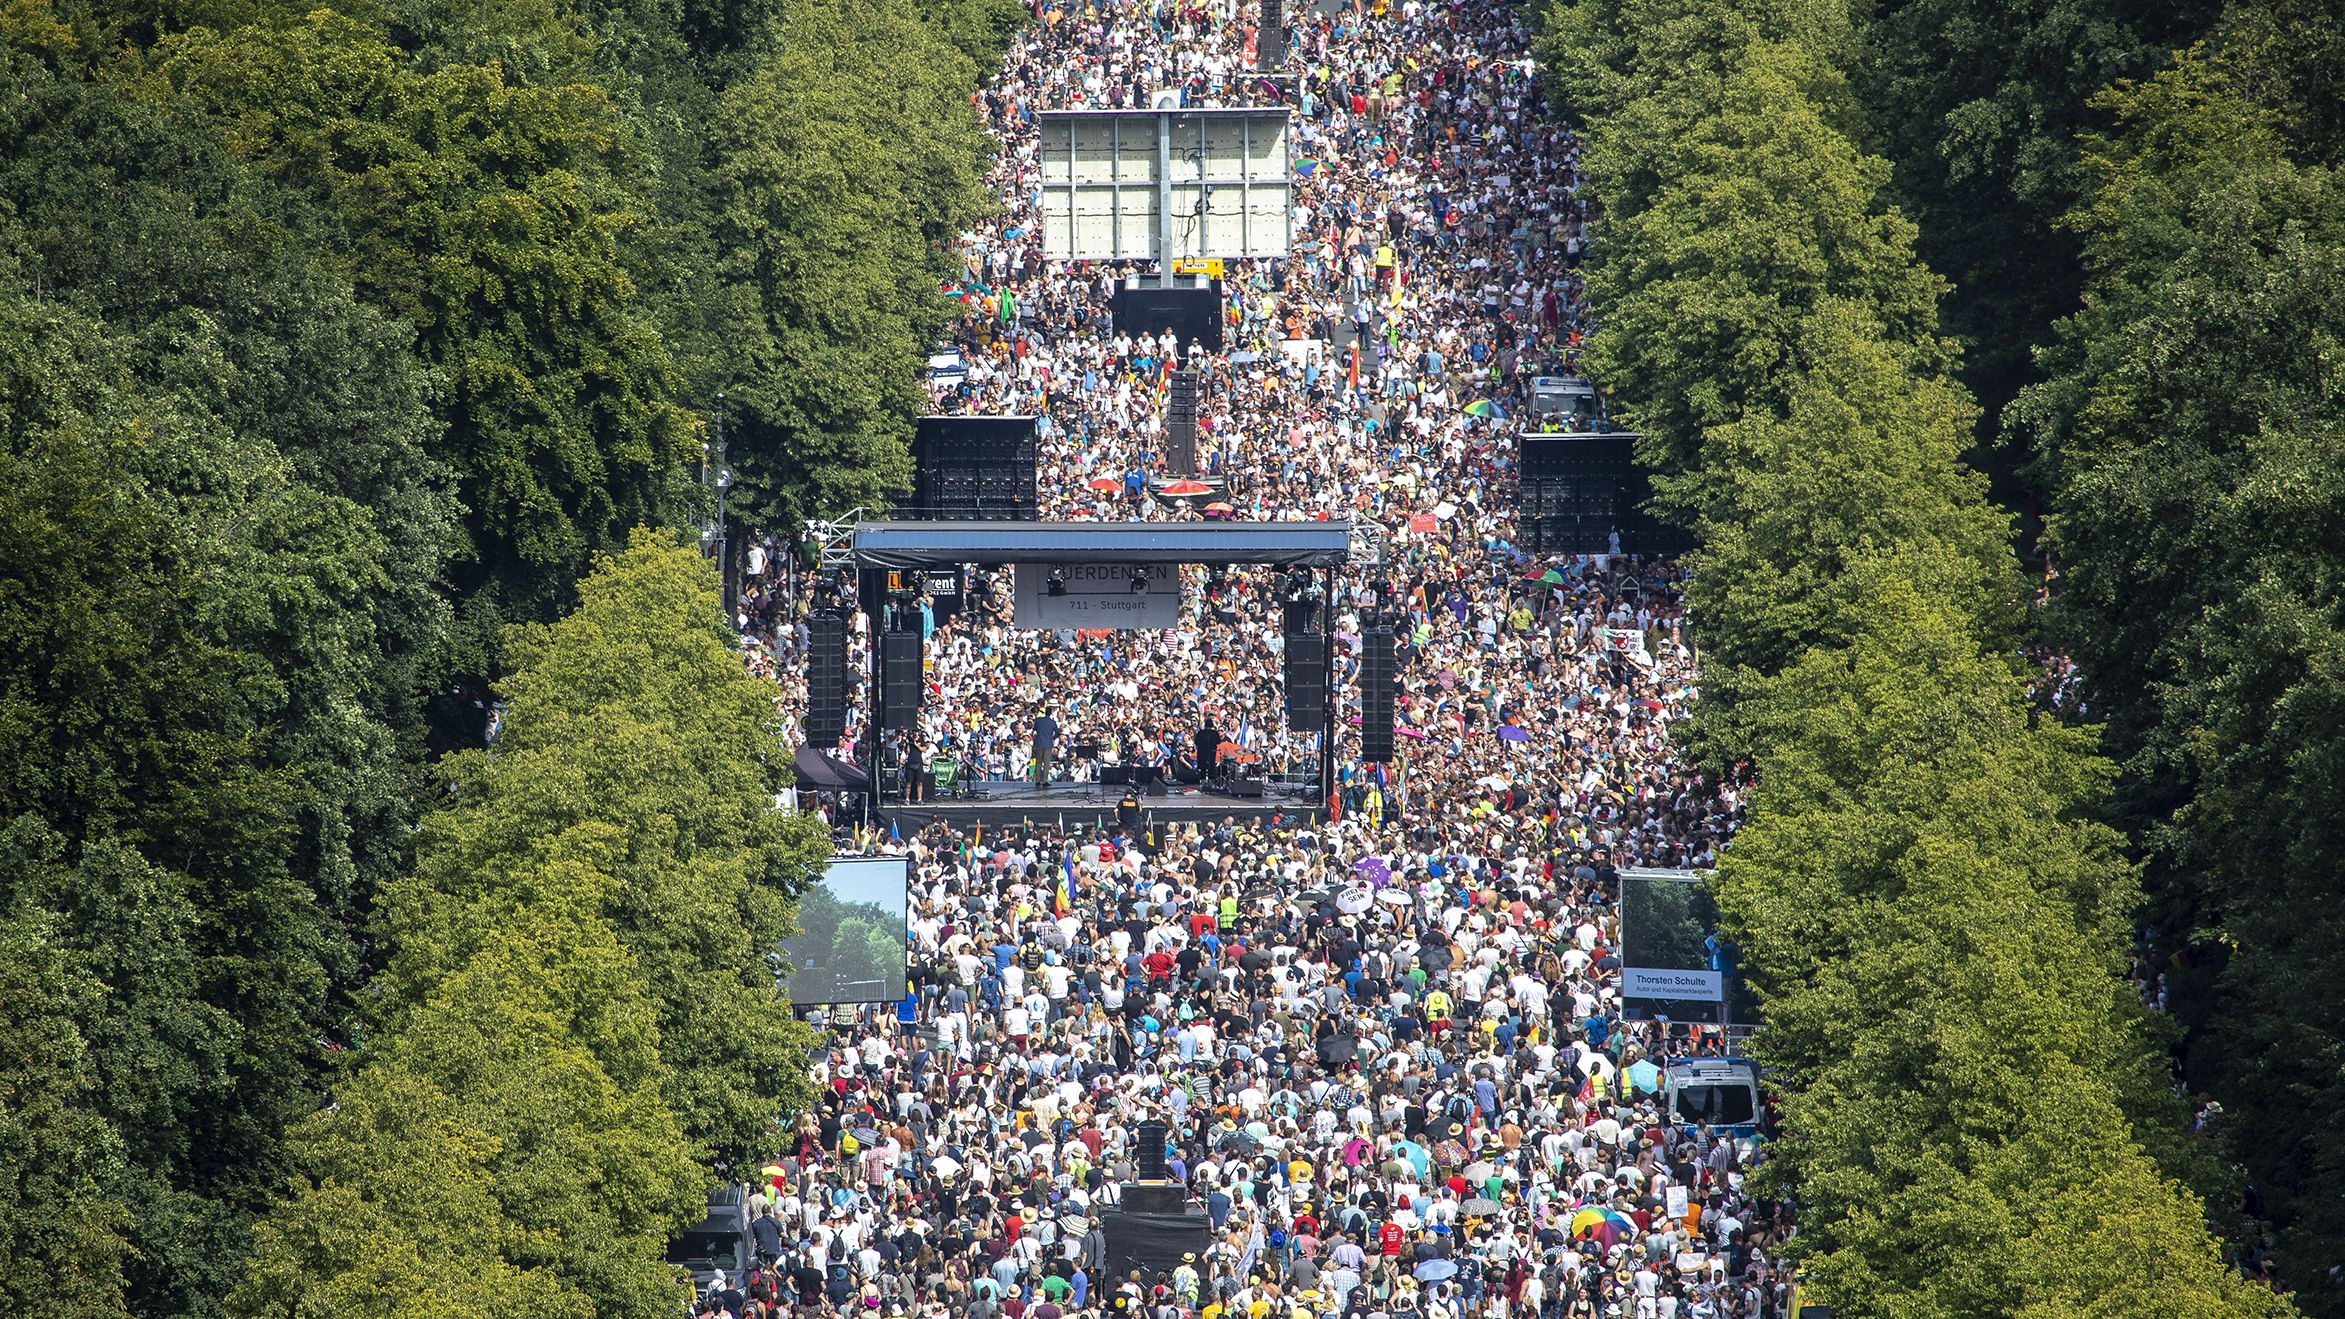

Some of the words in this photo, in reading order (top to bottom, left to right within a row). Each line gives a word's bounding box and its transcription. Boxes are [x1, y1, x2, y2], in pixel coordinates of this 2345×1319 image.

[1050, 566, 1168, 580] UERDENEN
[1069, 601, 1089, 610] 711
[1100, 601, 1146, 611] Stuttgart
[1347, 893, 1366, 904] SEIN
[1636, 975, 1672, 985] Thorsten
[1674, 976, 1706, 986] Schulte
